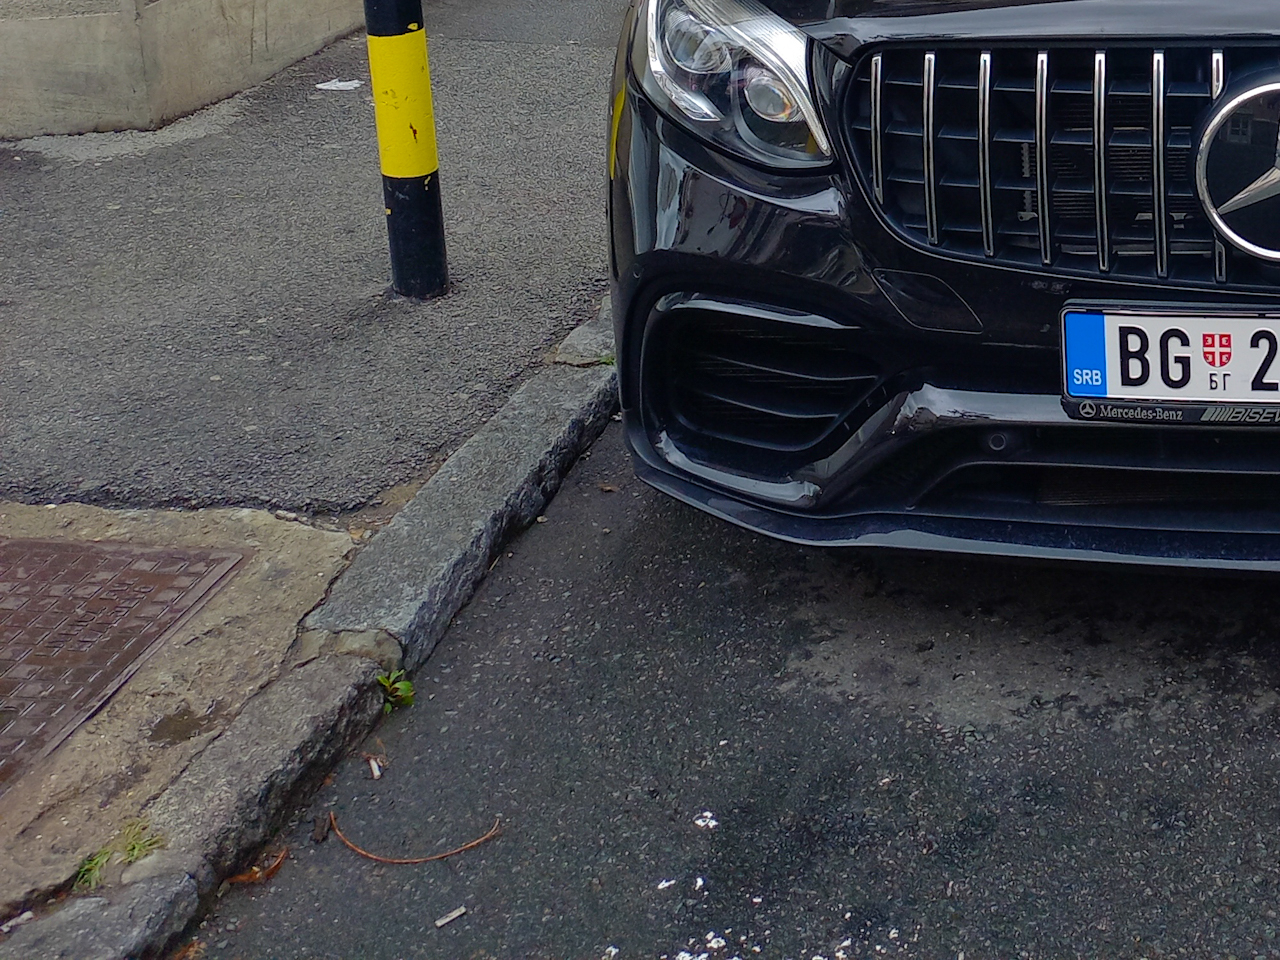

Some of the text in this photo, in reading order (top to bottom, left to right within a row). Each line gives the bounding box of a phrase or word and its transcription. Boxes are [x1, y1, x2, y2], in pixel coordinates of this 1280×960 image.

[1118, 326, 1192, 389] BG
[1073, 368, 1102, 386] SRB
[1100, 404, 1183, 421] Mercedes-Benz
